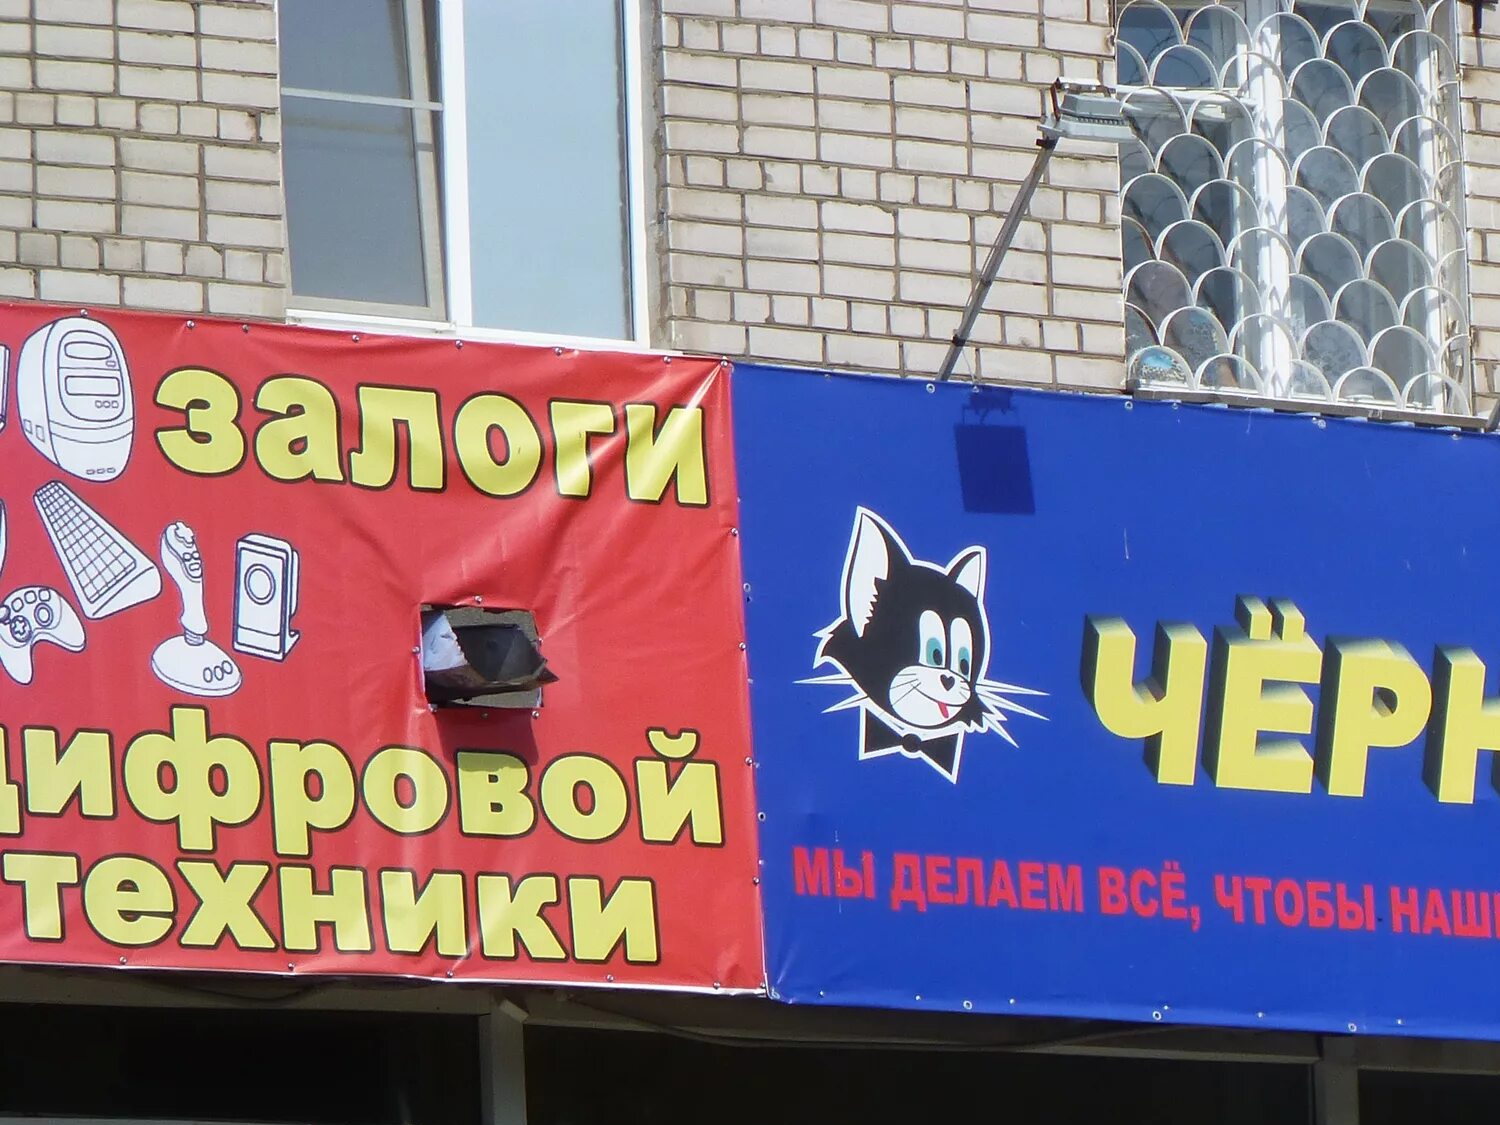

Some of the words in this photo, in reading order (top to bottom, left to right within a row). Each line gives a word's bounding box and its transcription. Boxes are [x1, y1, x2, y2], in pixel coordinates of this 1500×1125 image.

[153, 365, 712, 506] залоги
[0, 704, 726, 858] ифровой
[0, 849, 662, 964] техники
[792, 845, 877, 900] МЫ
[891, 851, 1085, 914] ДЕЛАЕМ
[1099, 860, 1201, 931] ВСЁ,
[1215, 874, 1376, 932] ЧТОБЫ
